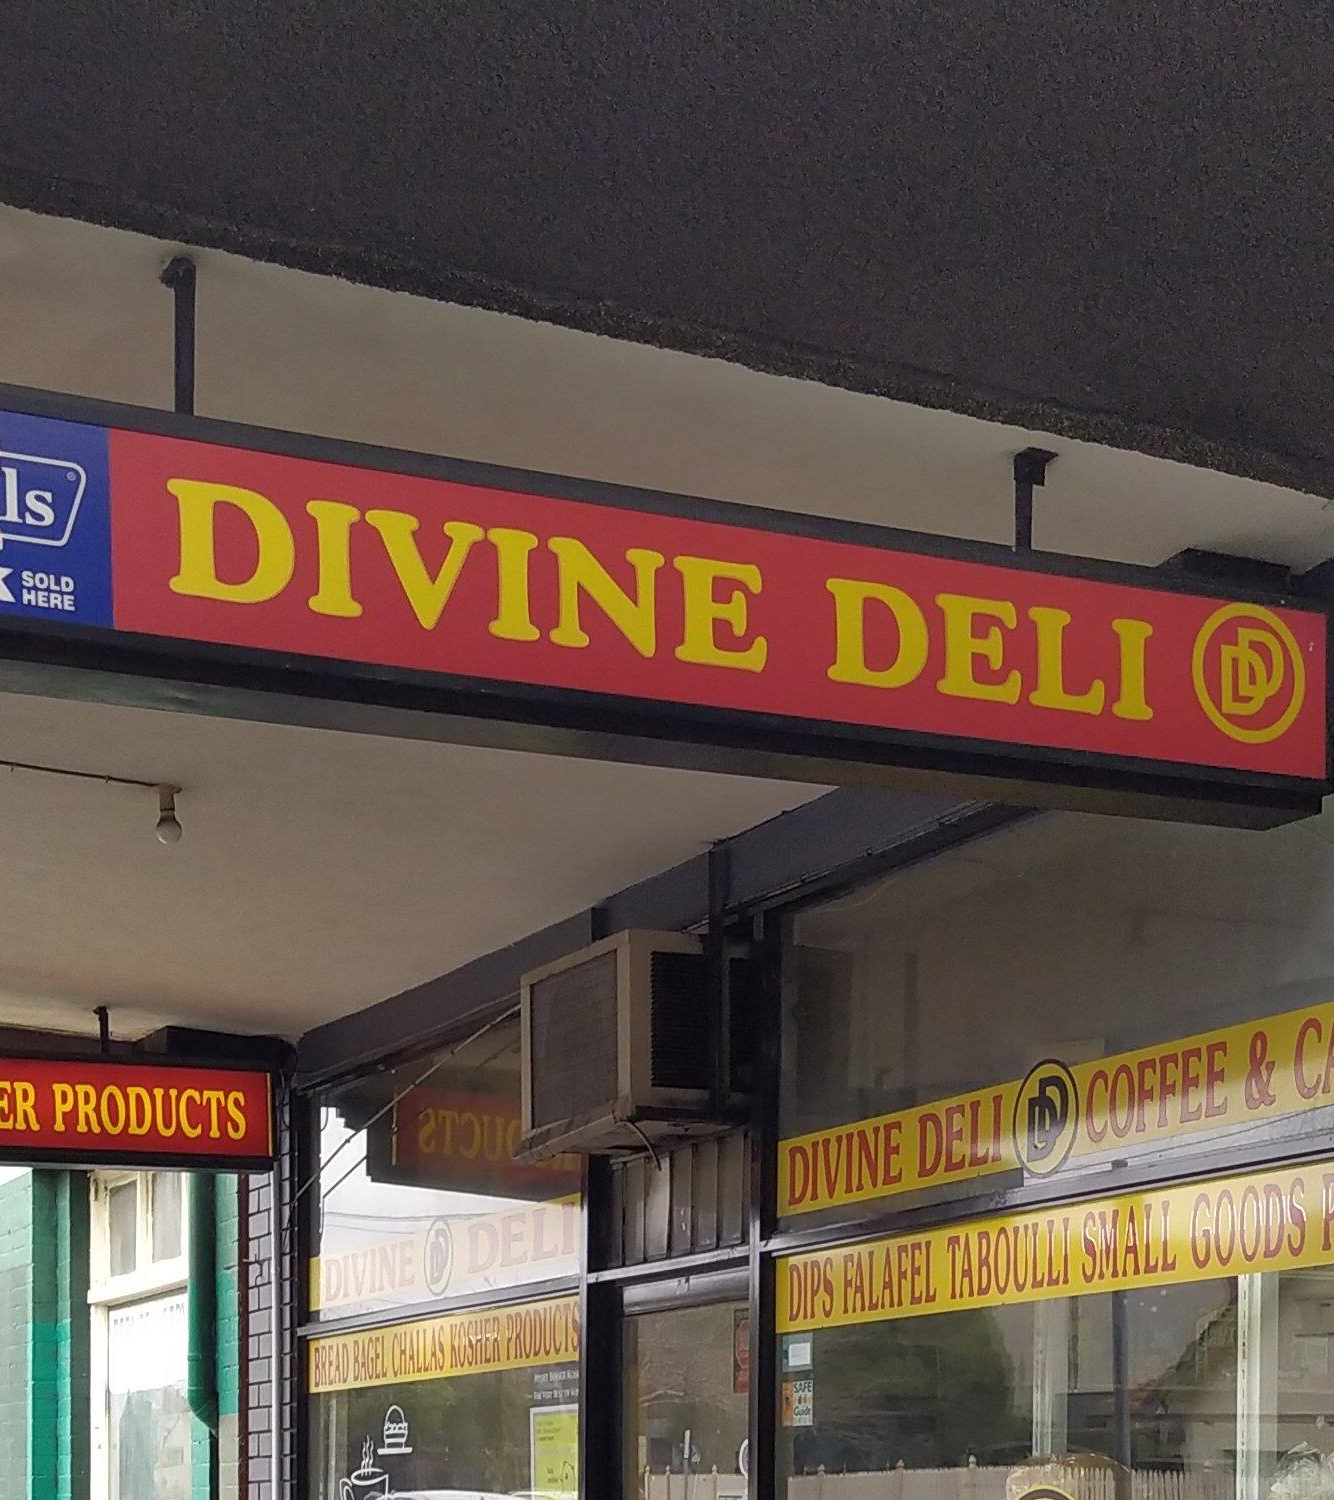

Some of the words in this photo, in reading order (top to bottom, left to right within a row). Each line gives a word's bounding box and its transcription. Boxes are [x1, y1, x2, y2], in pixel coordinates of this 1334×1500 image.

[22, 570, 74, 592] SOLD
[22, 587, 75, 611] HERE
[166, 478, 768, 673] DIVINE
[826, 578, 1153, 721] DELI
[54, 1083, 247, 1142] PRODUCTS
[788, 1121, 902, 1206] DIVINE
[918, 1094, 1003, 1179] DELI
[1086, 1041, 1227, 1143] COFFEE
[1244, 1031, 1275, 1110] &
[325, 1240, 414, 1302] DIVINE
[468, 1201, 576, 1273] DELI
[788, 1258, 834, 1322] DIPS
[842, 1241, 937, 1312] FALAFEL
[947, 1217, 1070, 1296] TABOULLI
[1081, 1202, 1176, 1280] SMALL
[1189, 1178, 1306, 1268] GOODS
[314, 1343, 348, 1387] BREAD
[353, 1335, 386, 1381] BAGEL
[392, 1325, 444, 1377] CHALLAS
[450, 1317, 500, 1368] KOSHER
[506, 1303, 579, 1360] PRODUCTS
[794, 1381, 812, 1393] SAFE
